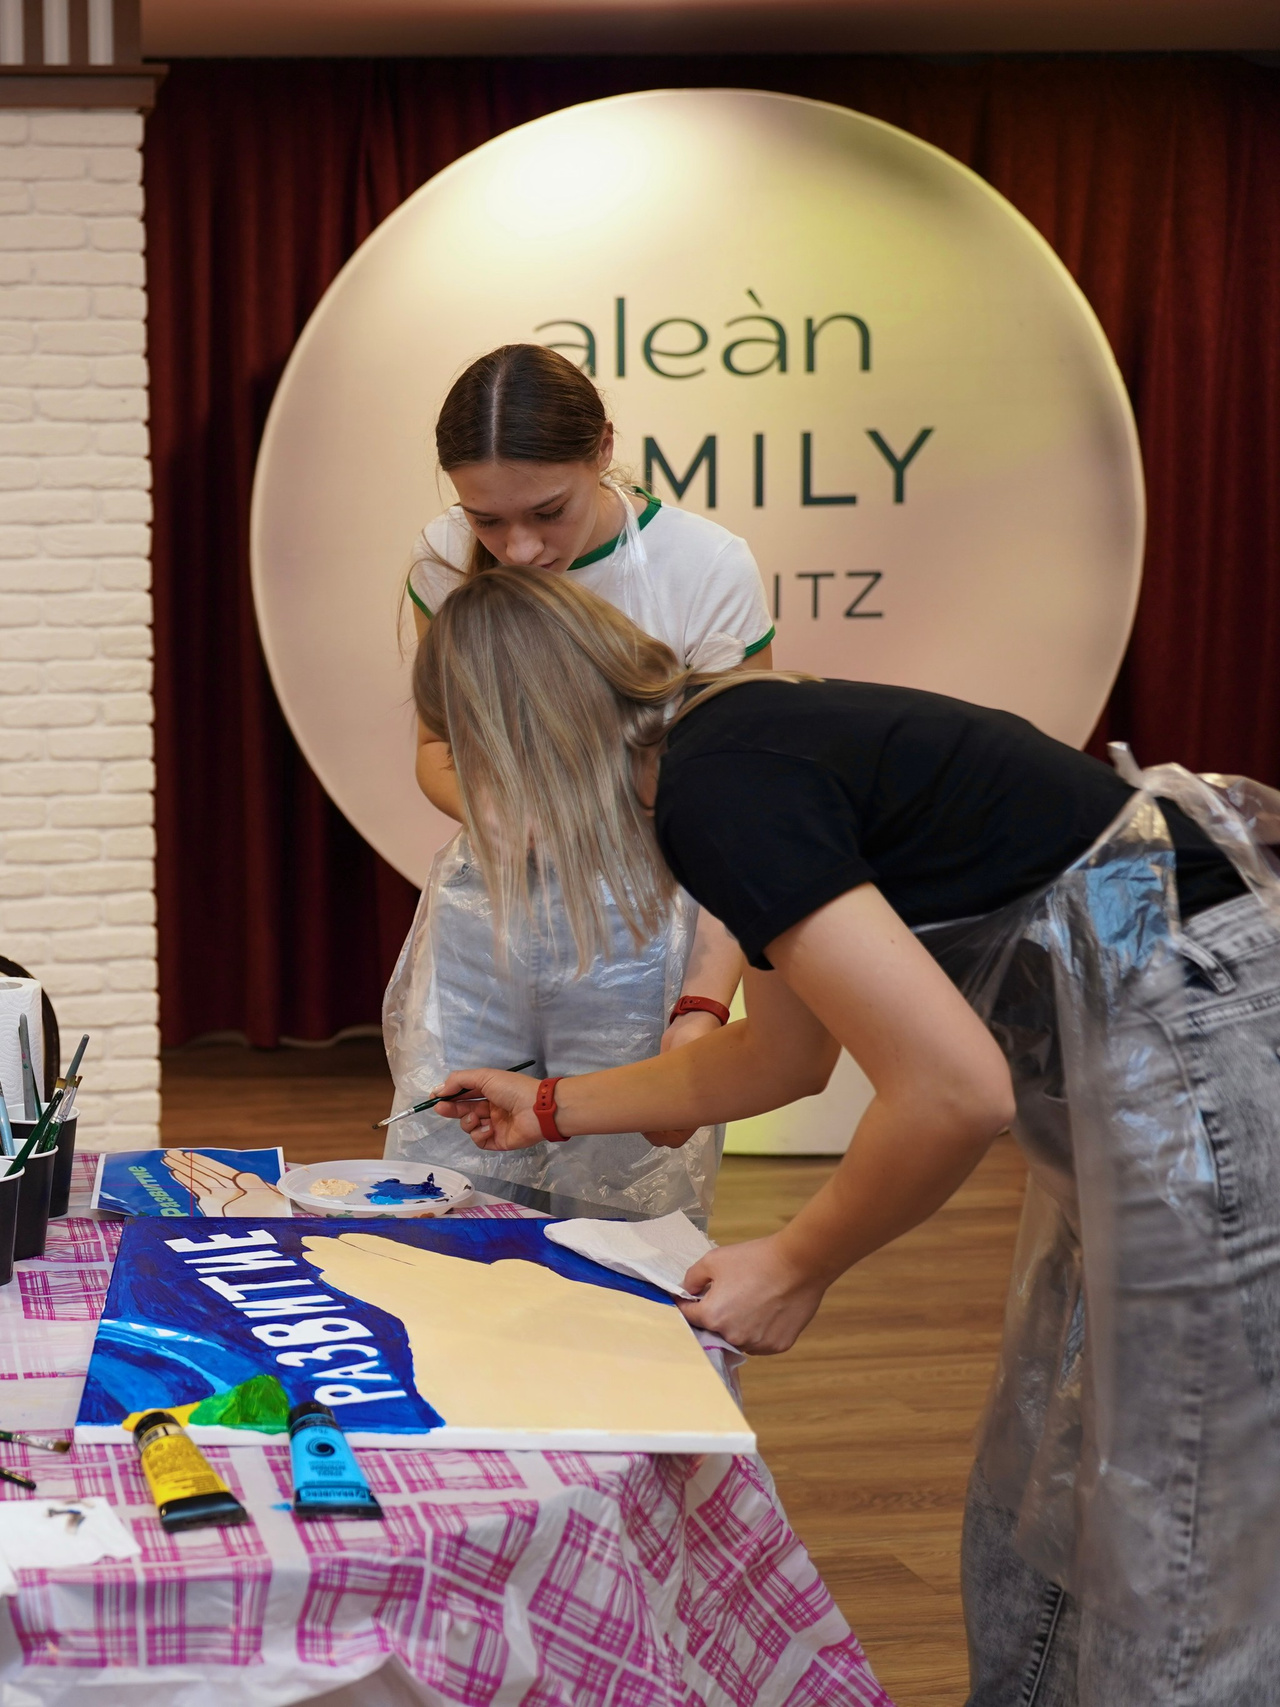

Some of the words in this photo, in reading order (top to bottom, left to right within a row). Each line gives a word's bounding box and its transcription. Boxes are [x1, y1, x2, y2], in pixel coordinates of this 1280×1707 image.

[533, 287, 872, 380] aleàn
[643, 426, 936, 511] MILY
[773, 570, 885, 620] ITZ
[128, 1165, 190, 1217] Развитие
[164, 1229, 408, 1407] РАЗВИТИЕ
